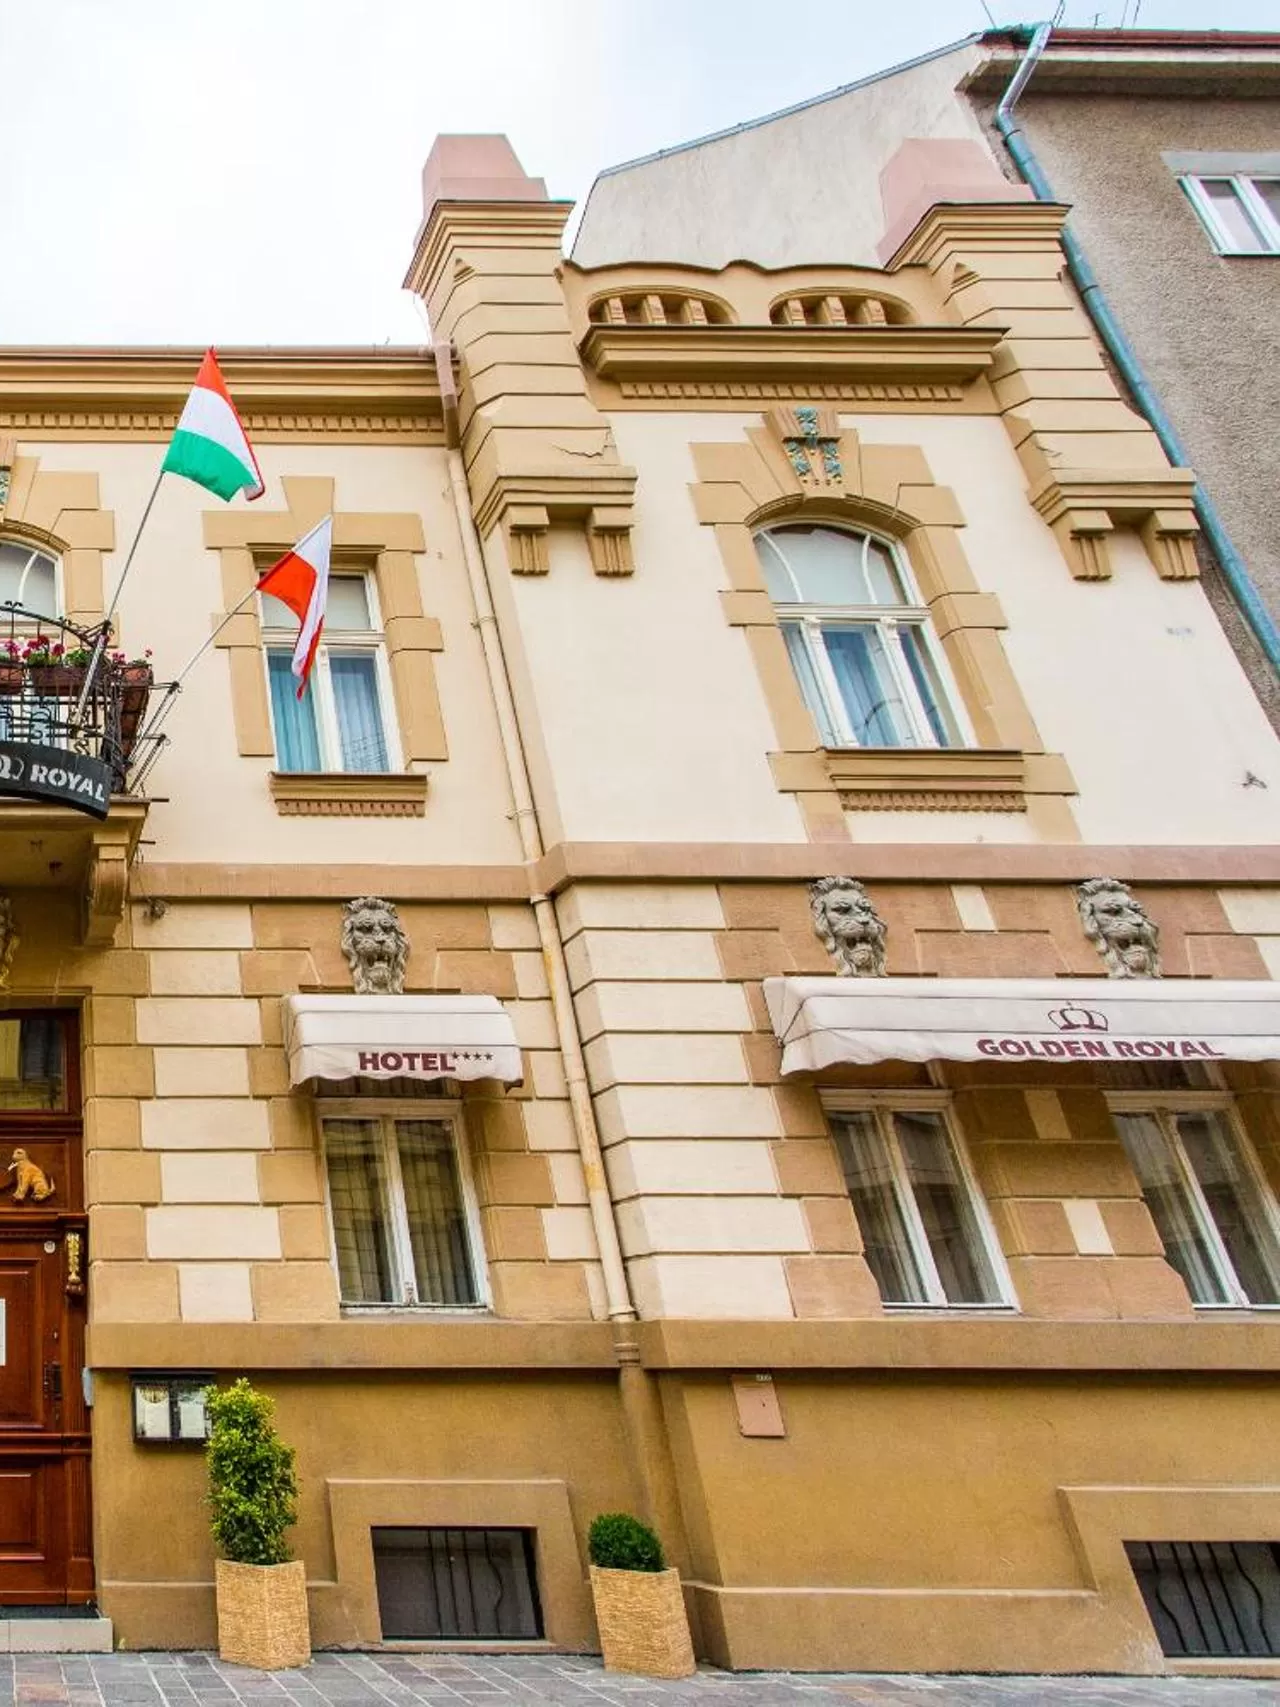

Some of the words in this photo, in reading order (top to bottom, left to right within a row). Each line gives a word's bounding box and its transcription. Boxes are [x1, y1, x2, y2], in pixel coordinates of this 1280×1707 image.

[30, 763, 105, 802] ROYAL
[976, 1038, 1108, 1058] GOLDEN
[1111, 1040, 1225, 1058] ROYAL
[358, 1052, 456, 1072] HOTEL
